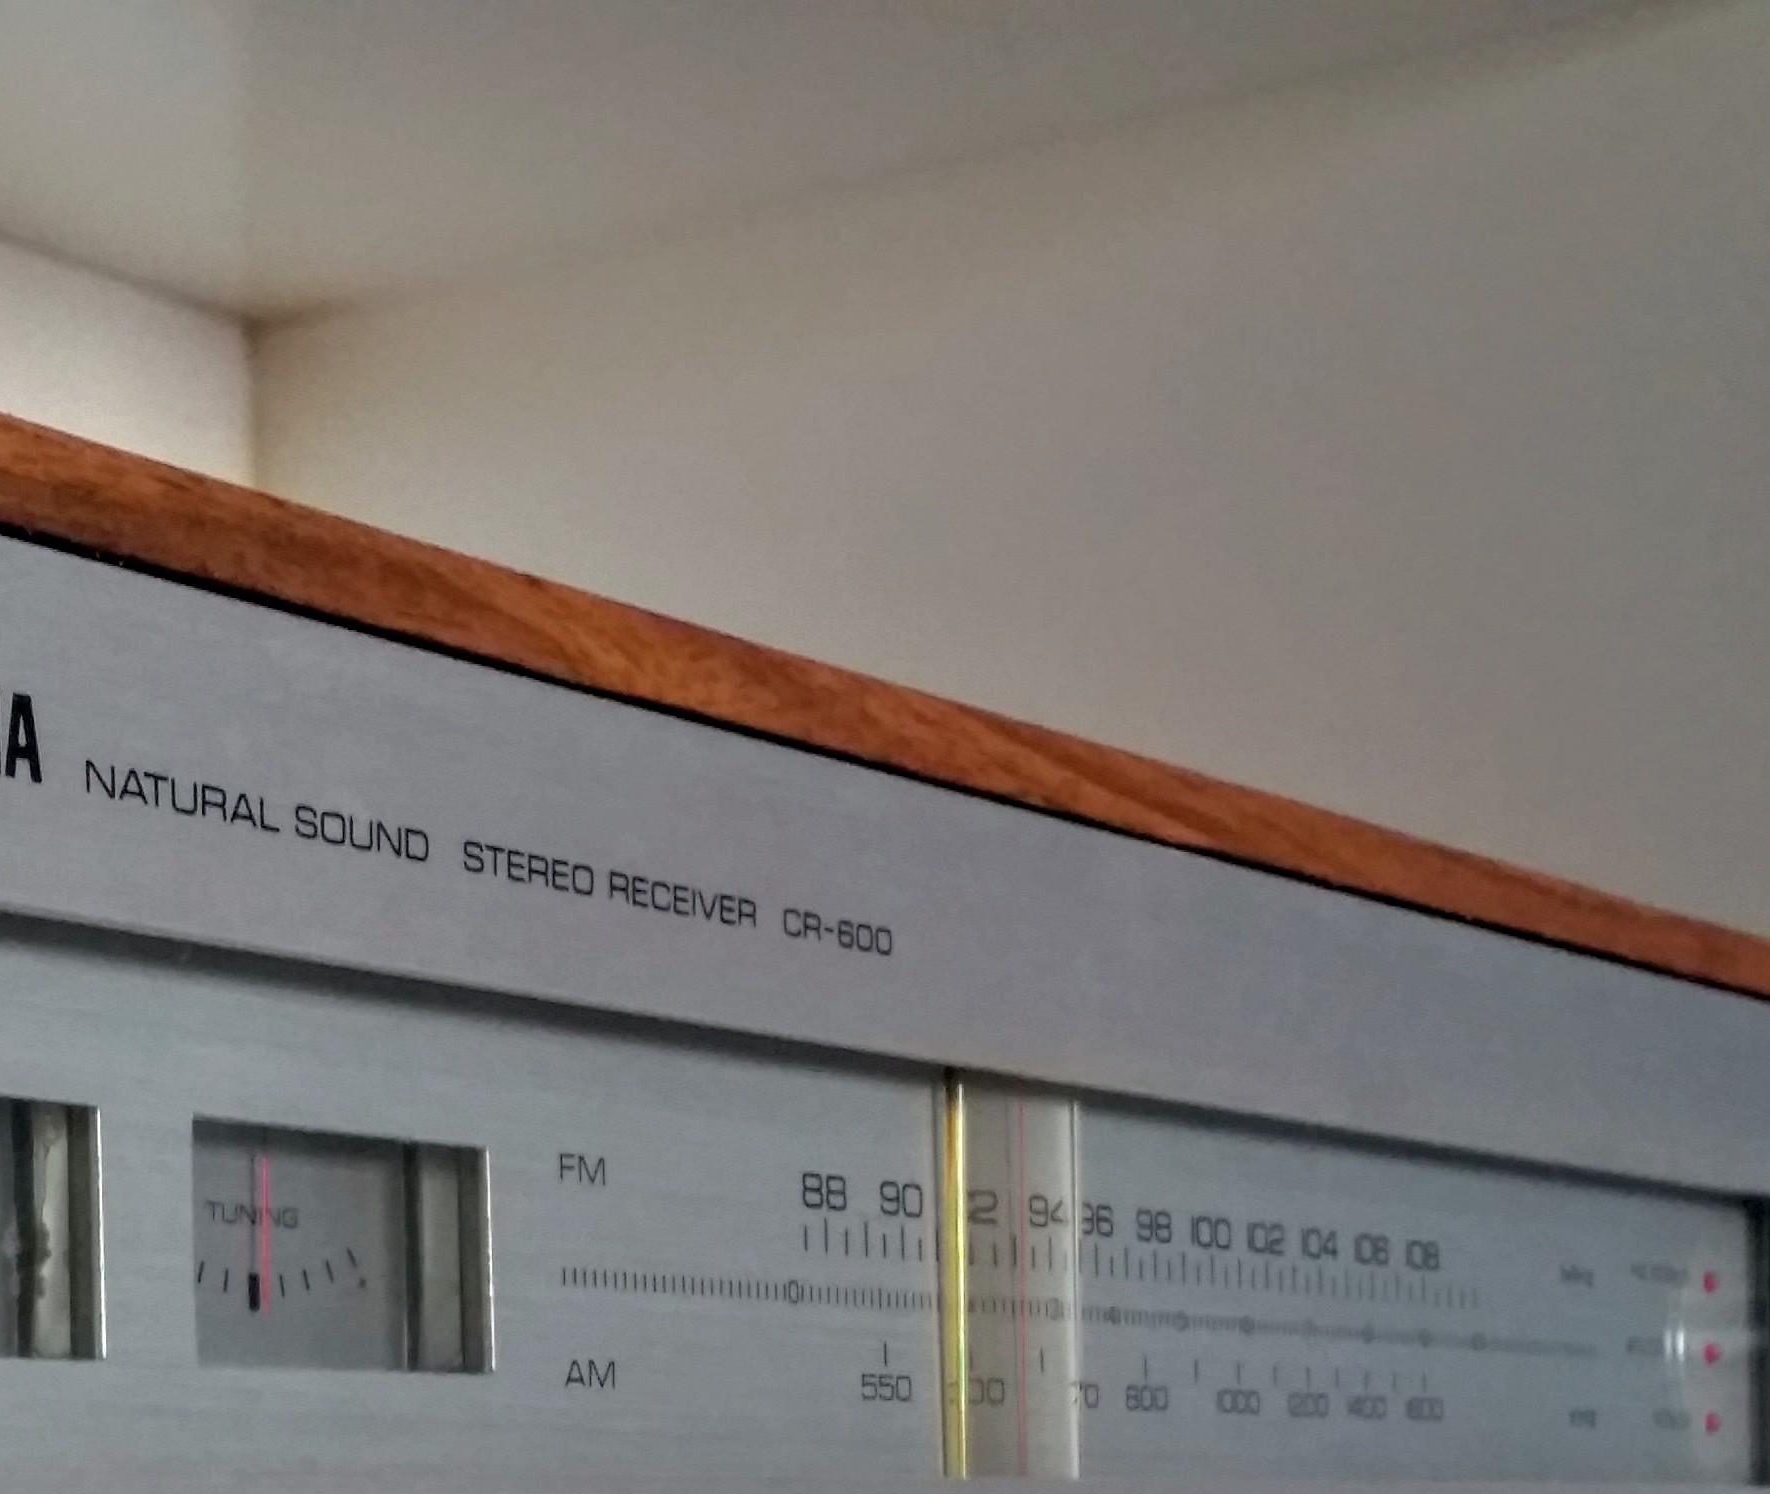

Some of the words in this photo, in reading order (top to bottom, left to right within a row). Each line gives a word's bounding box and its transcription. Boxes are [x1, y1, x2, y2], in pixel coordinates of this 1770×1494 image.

[85, 759, 281, 833] NATURAL
[294, 803, 430, 863] SOUND
[463, 839, 595, 897] STEREO
[608, 869, 757, 928] RECEIVER
[782, 907, 893, 957] CR-600
[559, 1152, 606, 1187] FM
[203, 1198, 300, 1230] TUNING
[801, 1172, 848, 1212] 88
[879, 1180, 923, 1219] 90
[1135, 1207, 1173, 1245] 98
[1190, 1215, 1232, 1251] 100
[1246, 1221, 1285, 1257] 102
[1301, 1227, 1339, 1260] 104
[564, 1359, 616, 1389] AM
[860, 1373, 912, 1403] 550
